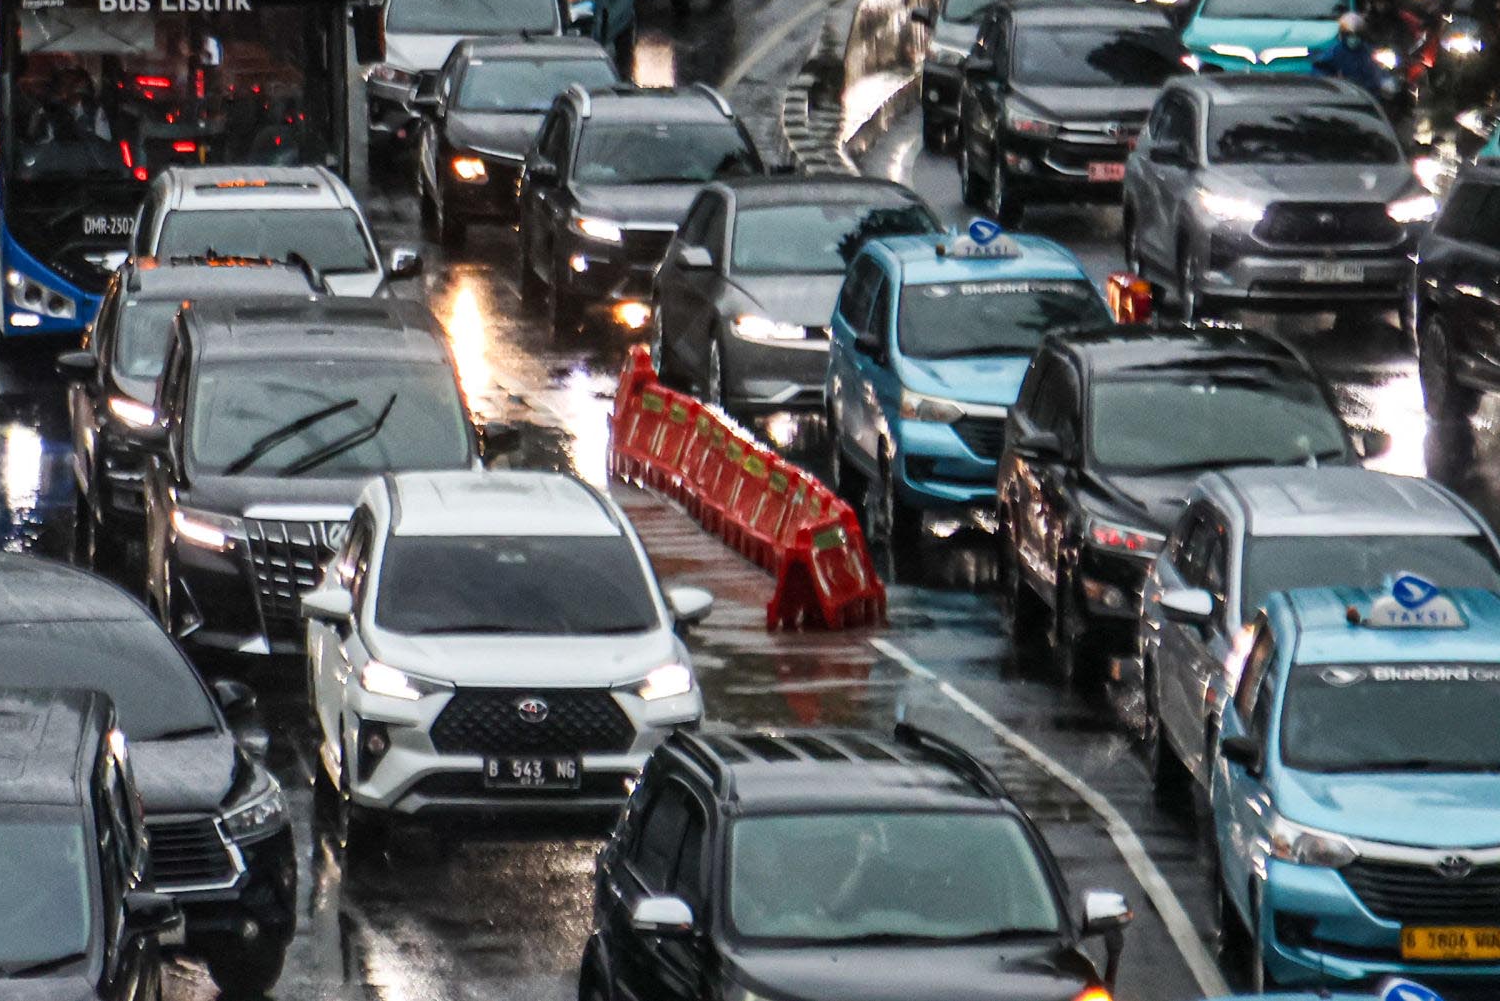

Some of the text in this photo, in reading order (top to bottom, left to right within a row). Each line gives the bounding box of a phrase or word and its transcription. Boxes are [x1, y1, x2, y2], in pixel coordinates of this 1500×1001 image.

[1388, 609, 1449, 623] TAKSI
[1373, 665, 1469, 682] Bluebird
[489, 760, 499, 777] B
[513, 760, 542, 778] 543
